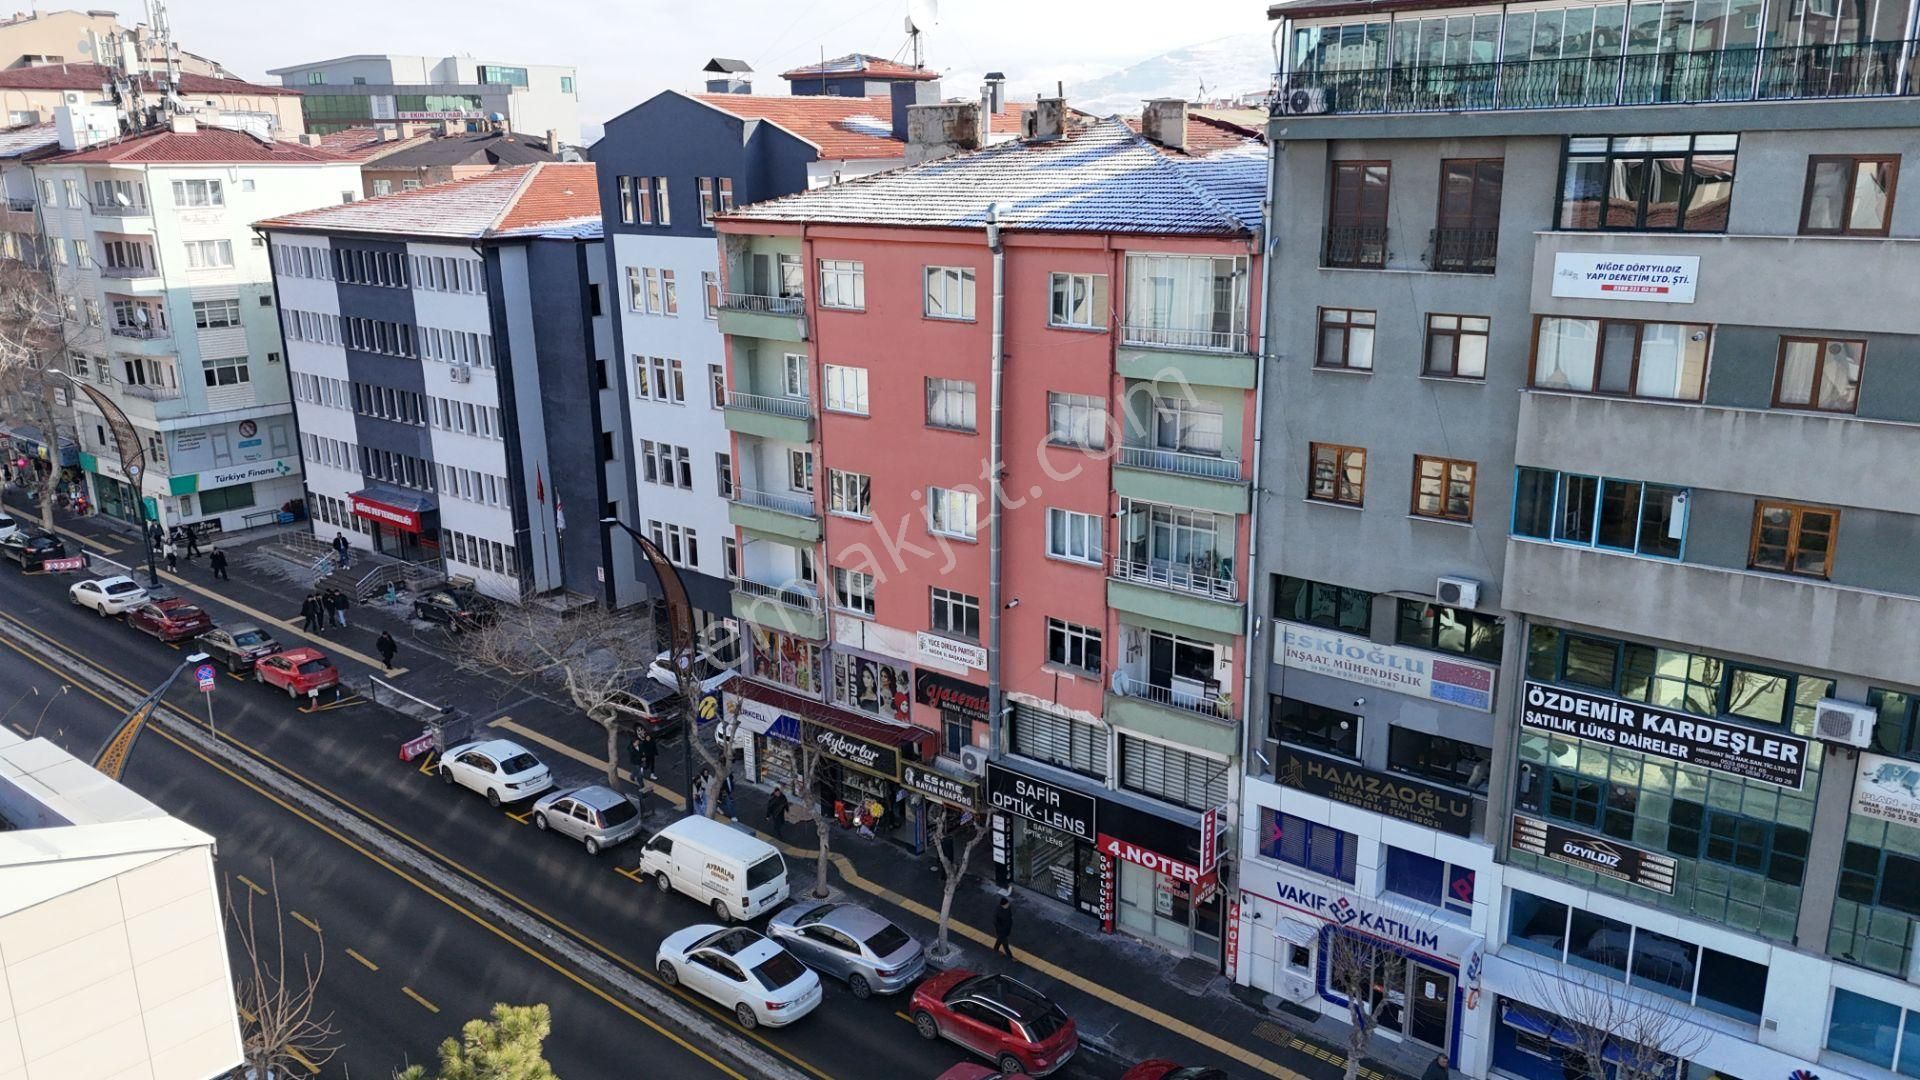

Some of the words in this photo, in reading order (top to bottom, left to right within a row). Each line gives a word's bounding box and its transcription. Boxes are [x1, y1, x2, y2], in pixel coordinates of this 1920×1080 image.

[1586, 272, 1607, 281] YAPI
[1608, 272, 1650, 283] DENETİM
[1651, 274, 1671, 284] LTD.
[1672, 274, 1690, 285] ŞTİ.
[1596, 262, 1624, 272] NİĞDE
[1625, 263, 1682, 274] DÖRTYILDIZ
[215, 471, 246, 483] Türkiye
[248, 467, 275, 477] Finans
[928, 638, 940, 648] YÜCE
[941, 640, 957, 654] DİRİLİŞ
[957, 646, 976, 658] PARTİSİ
[1281, 630, 1425, 676] ESKİOĞLU
[1333, 659, 1422, 688] MÜHENDİSLİK
[738, 707, 766, 723] URKCELL
[1528, 686, 1636, 727] ÖZDEMİR
[1642, 712, 1799, 765] KARDEŞLER
[817, 731, 879, 762] Aybarlar
[1526, 710, 1576, 734] SATILIK
[1579, 721, 1616, 743] LÜKS
[1619, 730, 1689, 760] DAİRELER
[916, 780, 939, 795] BAYAN
[939, 789, 972, 807] KUAFÖRÜ
[1015, 780, 1060, 808] SAFİR
[1307, 760, 1468, 818] HAMZAOĞLU
[1862, 792, 1899, 807] PLAN
[1390, 801, 1436, 819] EMLAK
[1859, 800, 1880, 808] MİMAR
[1107, 840, 1199, 885] 4.NOTER
[1562, 841, 1620, 868] ÖZYILDIZ
[1195, 882, 1217, 905] NOTER
[1276, 881, 1328, 911] VAKIF
[1358, 909, 1440, 951] KATILIM
